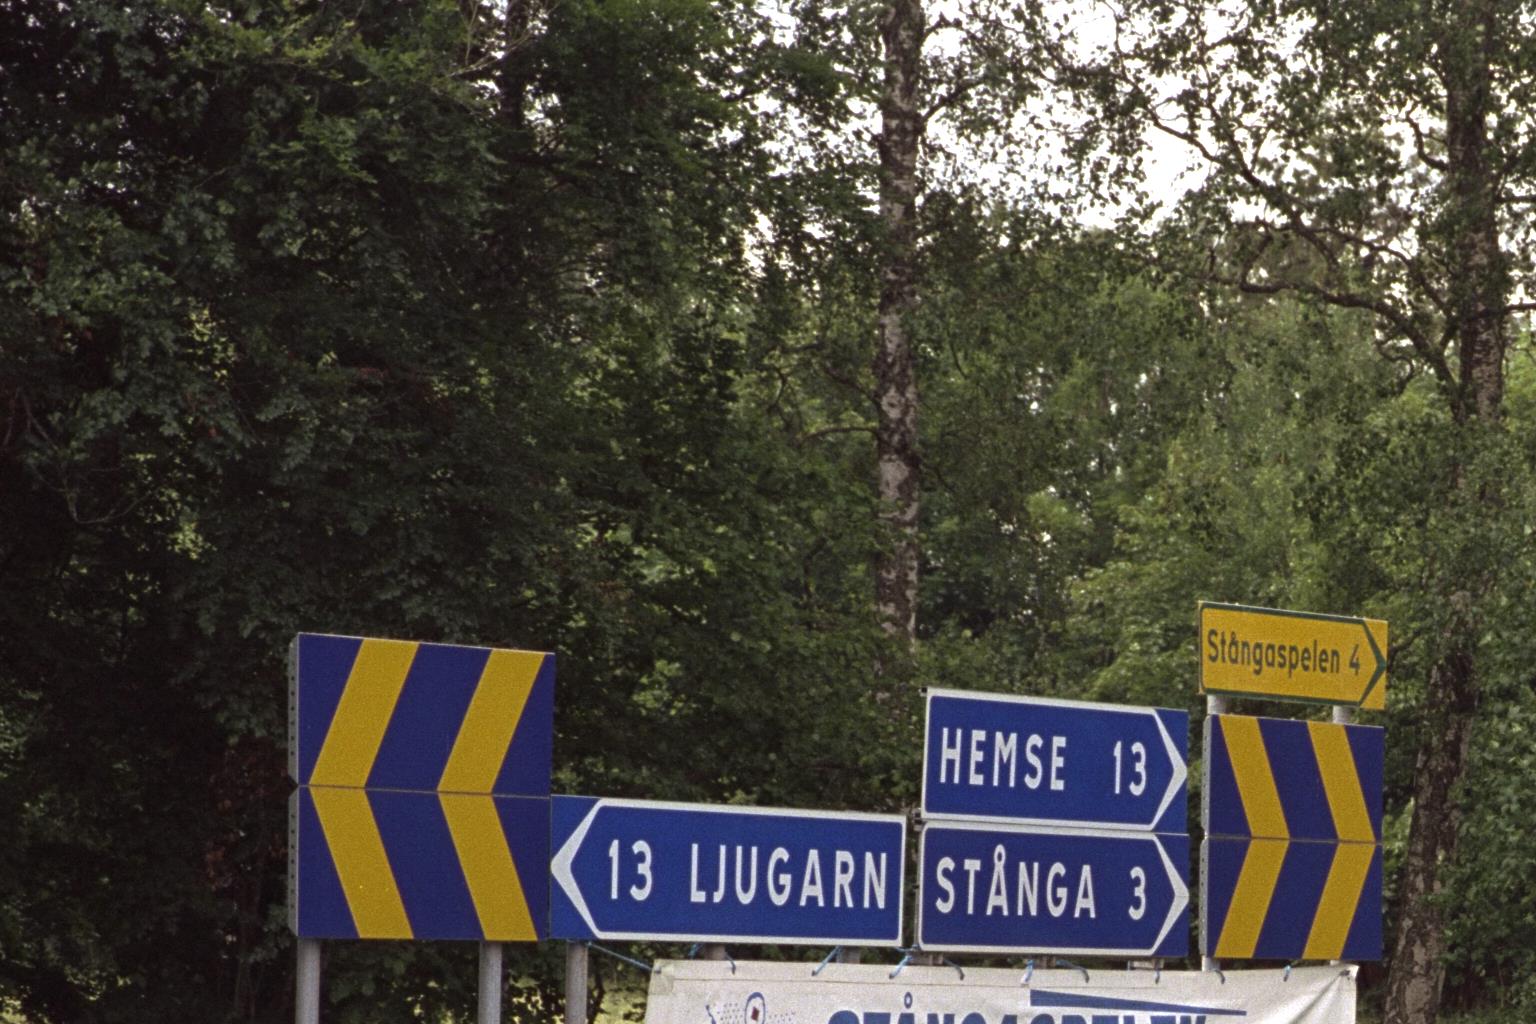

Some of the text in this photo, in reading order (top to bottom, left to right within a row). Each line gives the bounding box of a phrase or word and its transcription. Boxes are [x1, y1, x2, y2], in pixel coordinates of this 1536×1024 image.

[1208, 628, 1361, 678] Stångaspelen 4
[940, 727, 1147, 795] HEMSE 13
[609, 839, 887, 909] 13 LJUGARN
[935, 844, 1147, 921] STÅNGA 3
